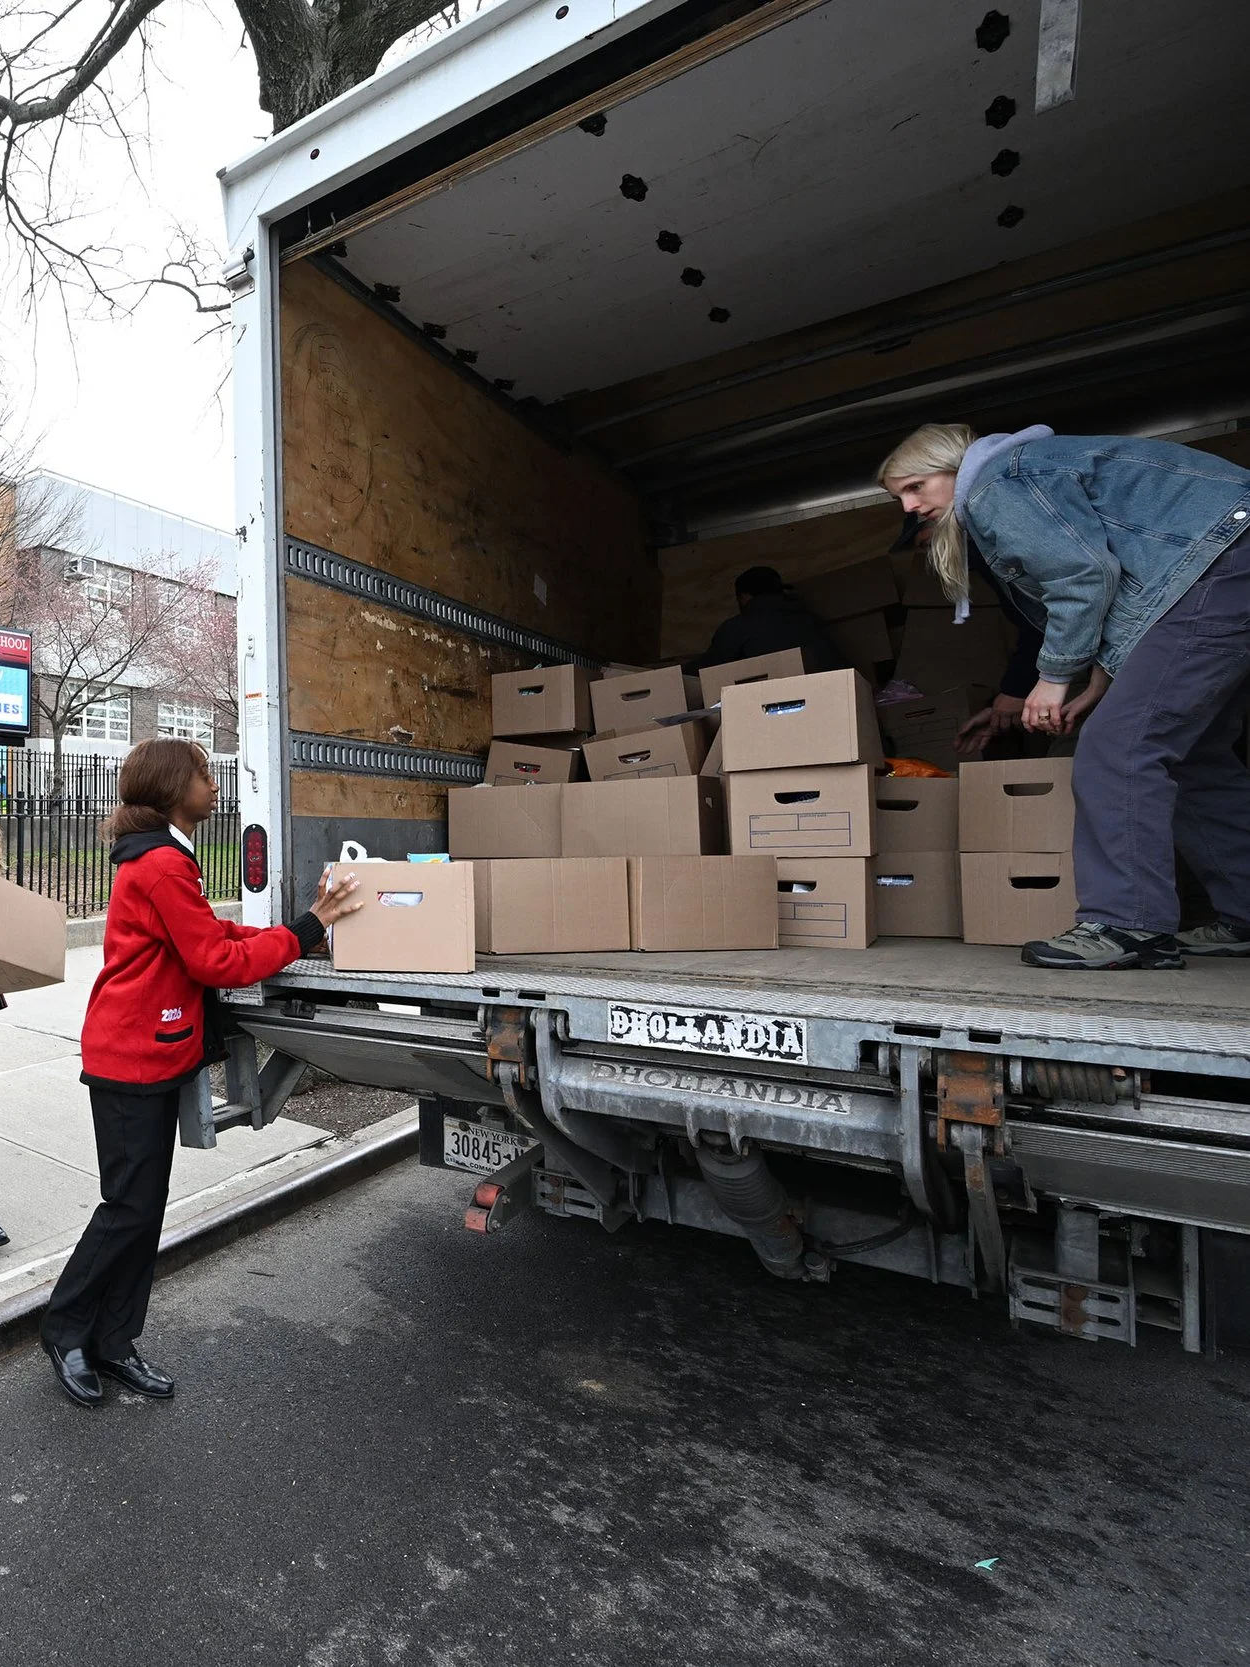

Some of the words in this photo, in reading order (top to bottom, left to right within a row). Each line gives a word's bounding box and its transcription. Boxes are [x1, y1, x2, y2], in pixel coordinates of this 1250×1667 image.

[610, 1010, 803, 1054] DHOLLANDIA
[592, 1061, 848, 1114] DHOLLANDIA
[469, 1127, 489, 1139] NEW
[491, 1132, 518, 1146] YORK
[469, 1162, 498, 1174] COMME
